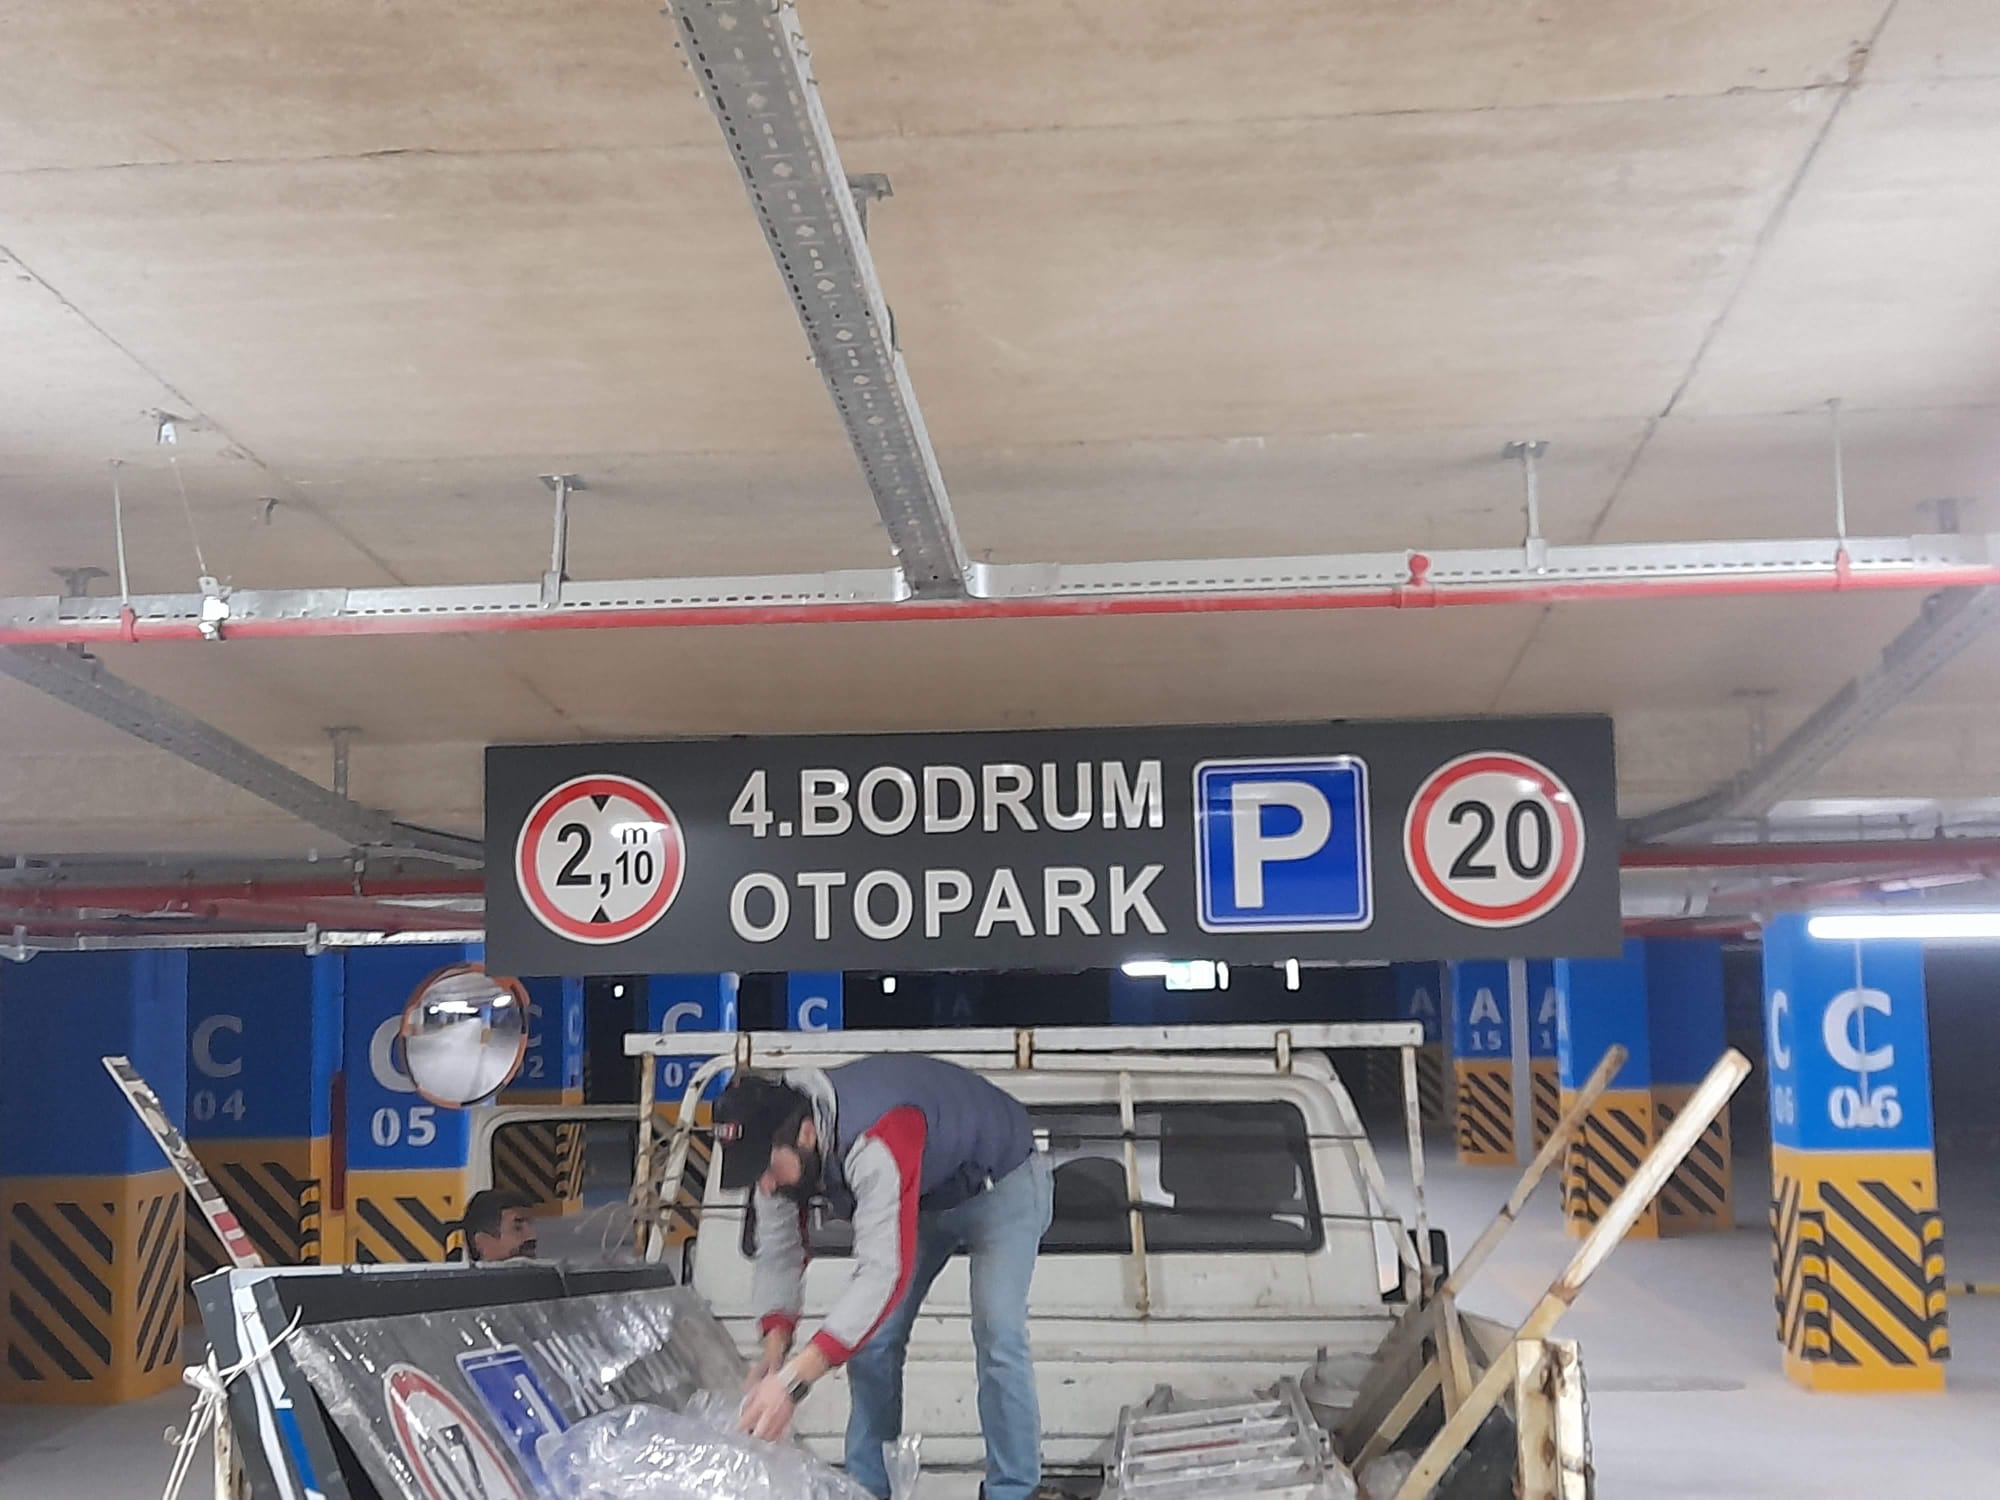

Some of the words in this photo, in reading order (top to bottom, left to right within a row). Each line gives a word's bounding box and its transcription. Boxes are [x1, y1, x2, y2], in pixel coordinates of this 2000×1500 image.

[729, 760, 1165, 838] 4.BODRUM
[1231, 781, 1332, 909] P
[1447, 800, 1553, 880] 20
[729, 865, 1168, 942] OTOPARK
[798, 997, 829, 1032] C
[1469, 987, 1503, 1025] A
[1771, 990, 1791, 1070] C
[1823, 988, 1895, 1073] C
[192, 1015, 243, 1078] C
[193, 1089, 245, 1121] 04
[371, 1107, 436, 1147] 05
